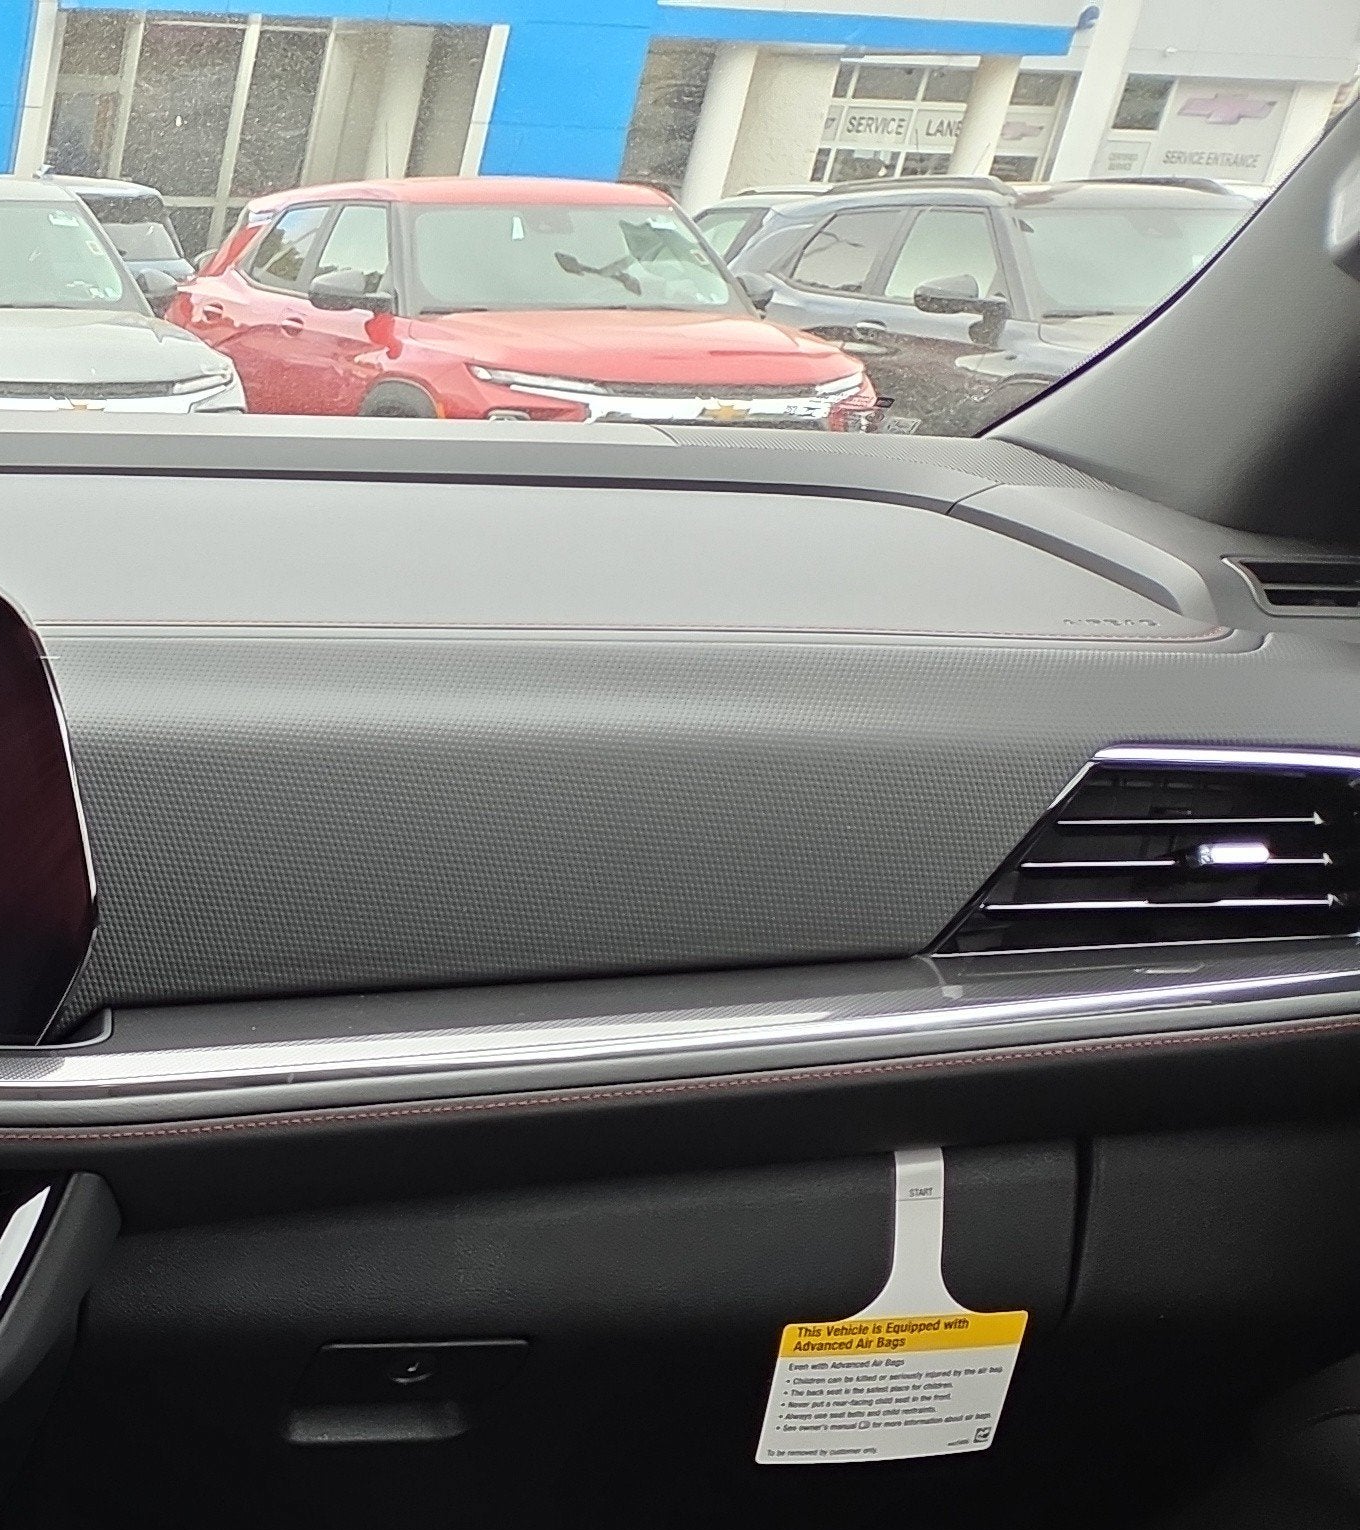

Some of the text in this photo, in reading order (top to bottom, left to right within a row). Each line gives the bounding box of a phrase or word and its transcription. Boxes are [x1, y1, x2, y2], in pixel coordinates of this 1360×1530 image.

[846, 116, 907, 136] SERVICE
[797, 1317, 970, 1338] This Vehicle is Equipped with
[793, 1336, 907, 1352] Advanced Air Bags
